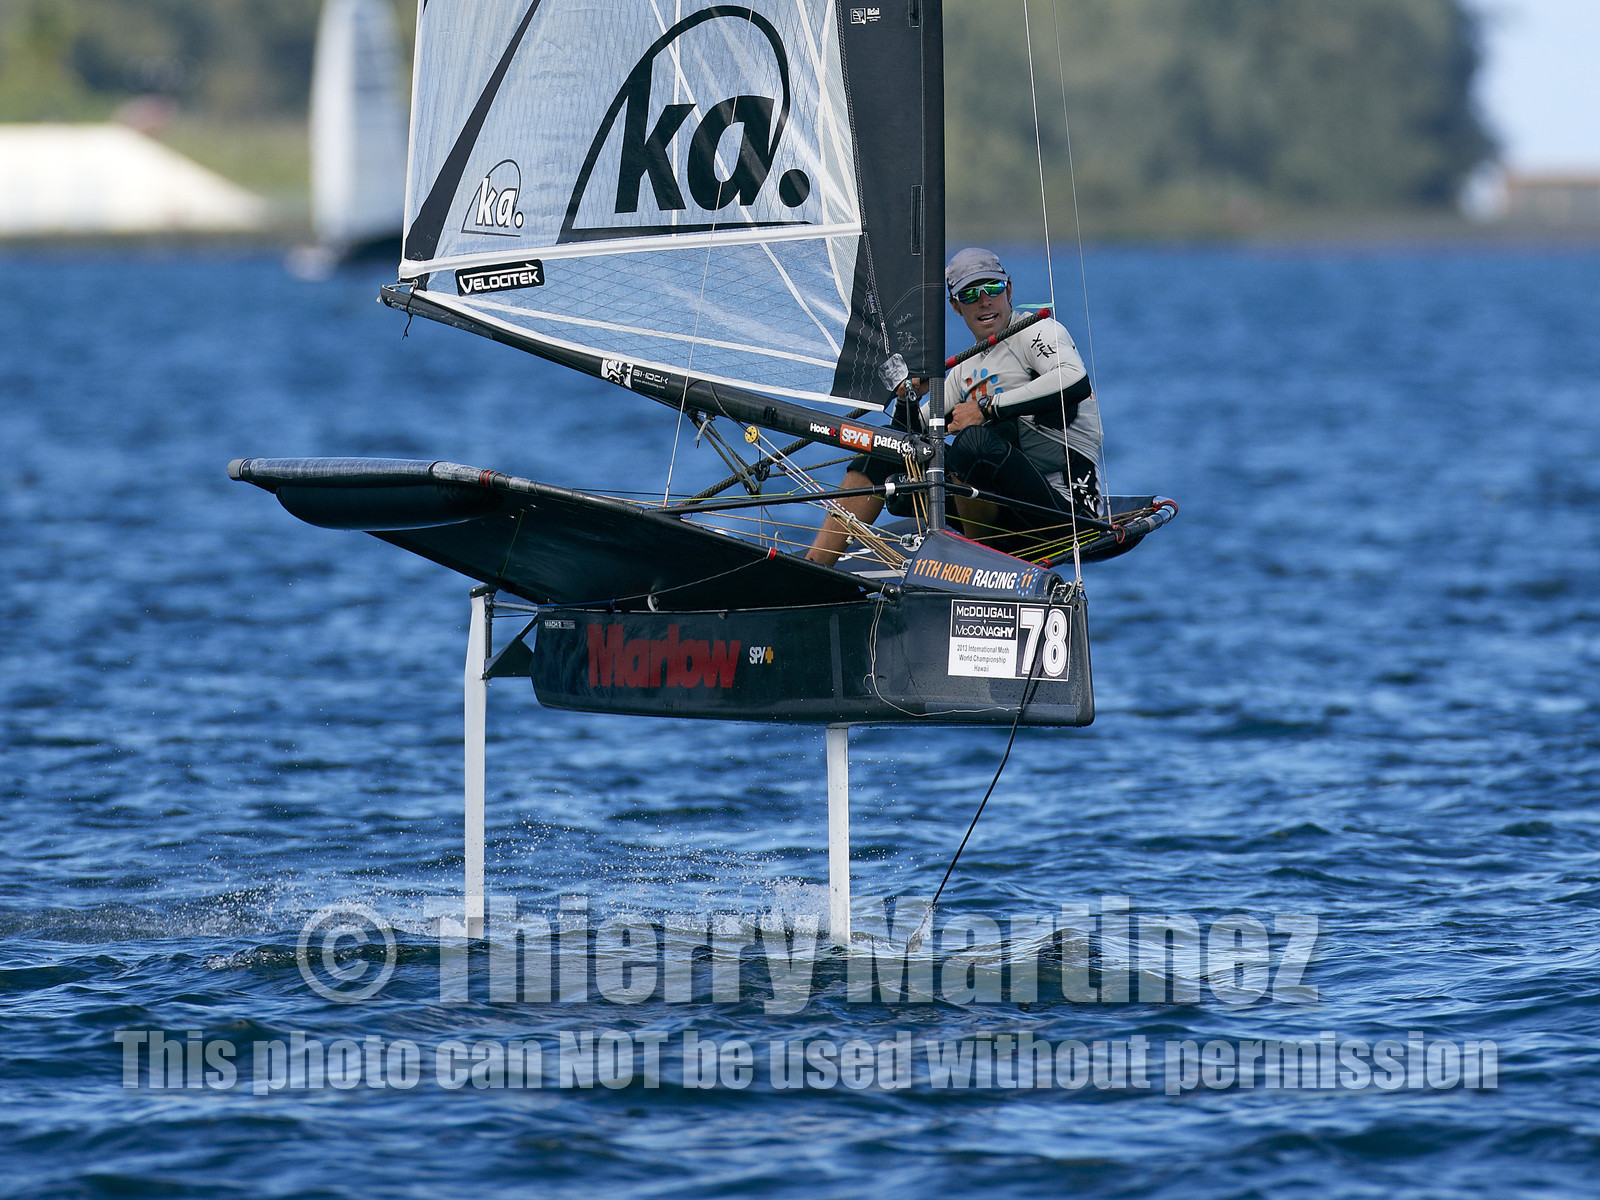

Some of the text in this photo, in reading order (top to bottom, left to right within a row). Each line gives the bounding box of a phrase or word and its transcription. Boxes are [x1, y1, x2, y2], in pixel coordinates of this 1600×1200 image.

[459, 271, 540, 294] VELOCITEK
[913, 558, 1018, 590] 11TH HOUR RACING
[957, 644, 968, 652] 2013
[968, 644, 997, 653] International
[1019, 607, 1068, 677] 78
[587, 624, 742, 688] Marlow
[958, 654, 1007, 664] World Championship
